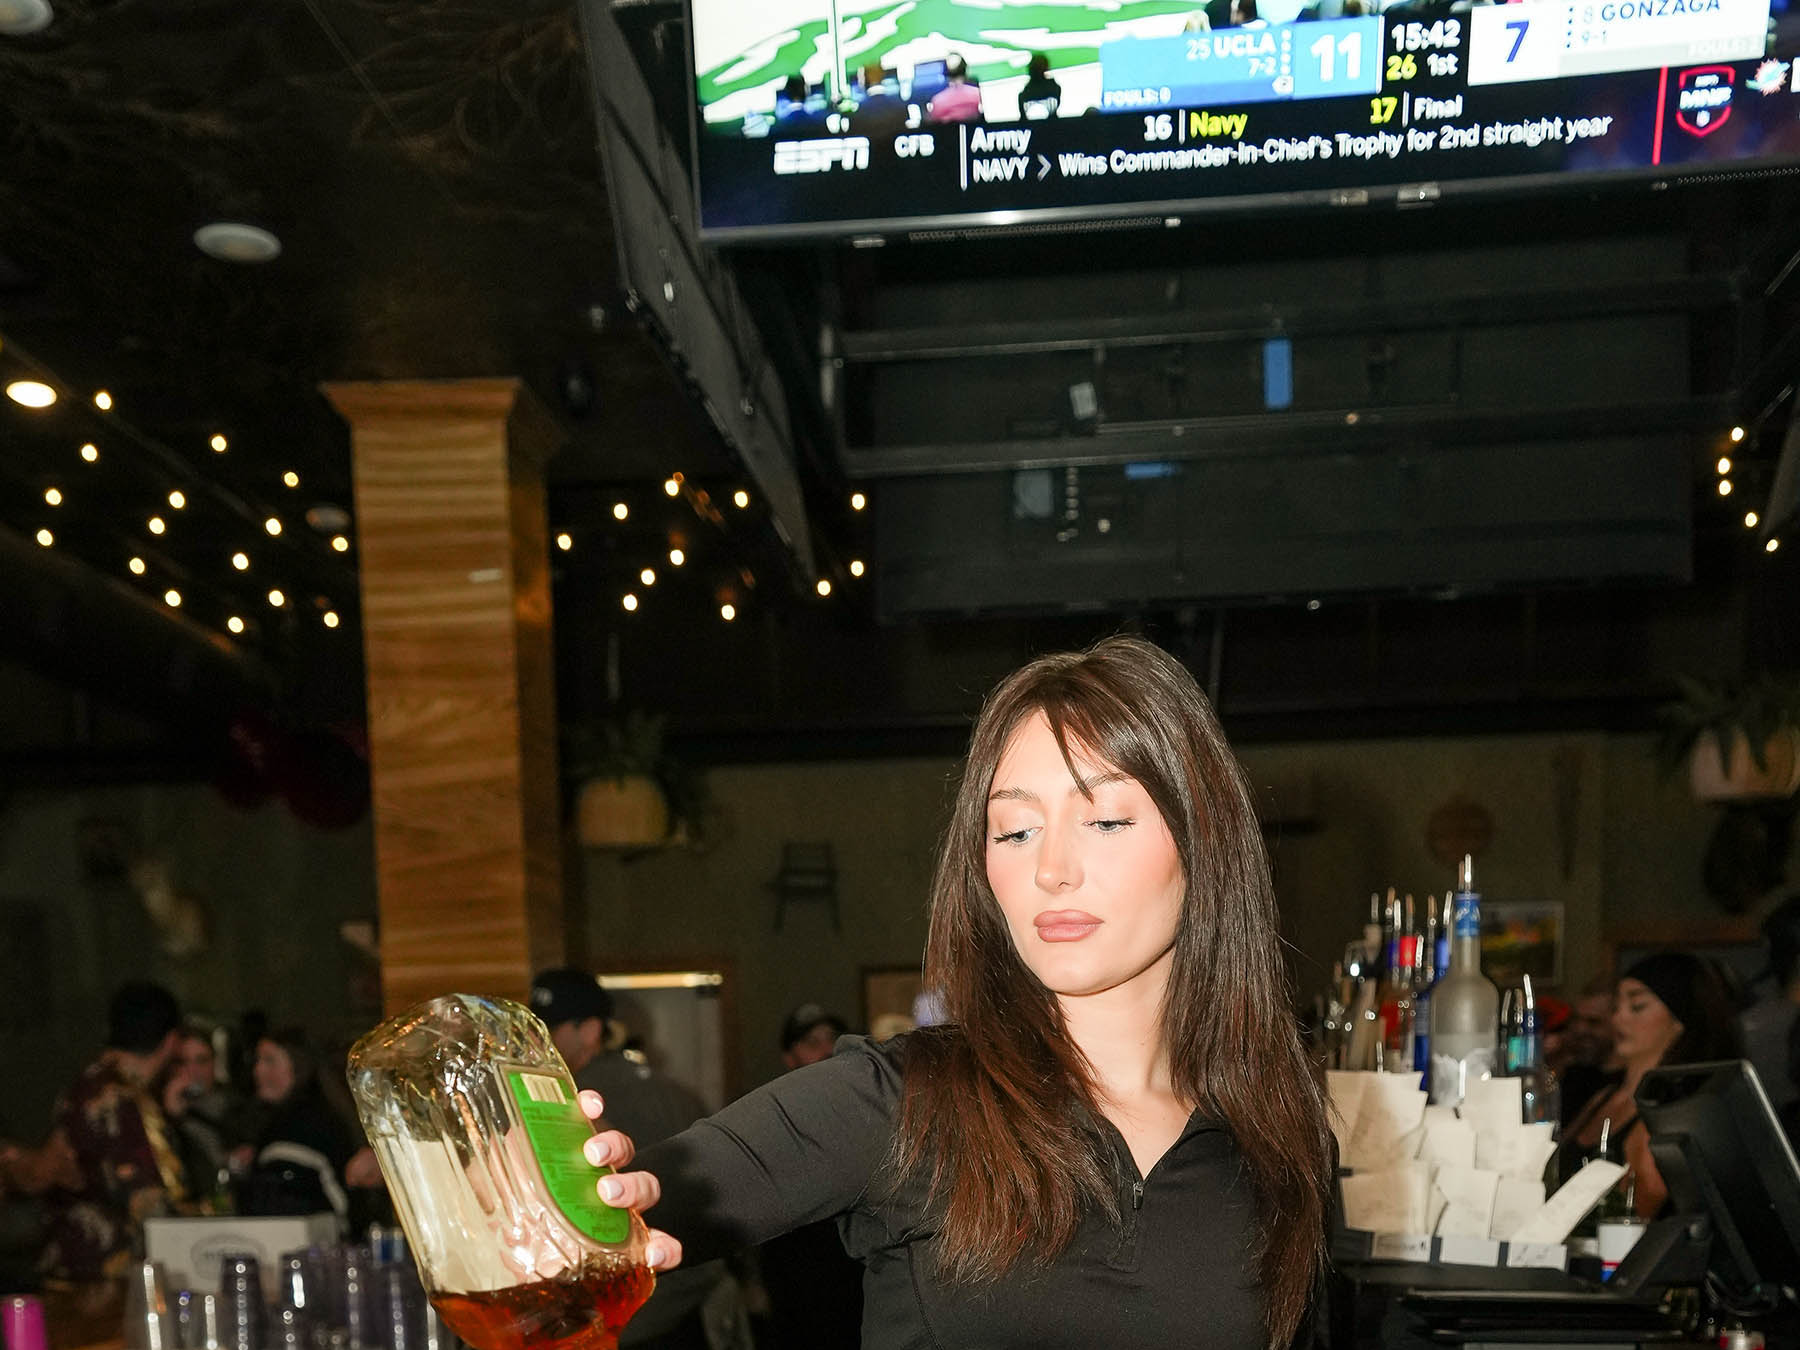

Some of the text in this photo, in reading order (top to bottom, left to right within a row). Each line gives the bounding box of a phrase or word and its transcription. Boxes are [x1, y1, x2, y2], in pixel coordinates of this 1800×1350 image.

[1186, 32, 1277, 61] 25 UCLA
[1391, 19, 1462, 52] 15:42
[1505, 20, 1530, 63] 7
[1249, 56, 1277, 78] 7-2
[1310, 32, 1363, 82] 11
[1386, 53, 1459, 81] 26 1st
[1190, 97, 1398, 140] Navy 17
[1414, 94, 1463, 121] Final
[894, 134, 935, 158] CFB
[970, 114, 1173, 155] Army 16
[972, 156, 1030, 183] NAVY
[1058, 152, 1108, 177] Wins
[1335, 132, 1404, 160] Trophy
[1406, 127, 1438, 152] for
[1439, 123, 1480, 150] 2nd
[1483, 117, 1563, 147] straight
[1565, 115, 1614, 144] year
[773, 136, 870, 175] ESPN
